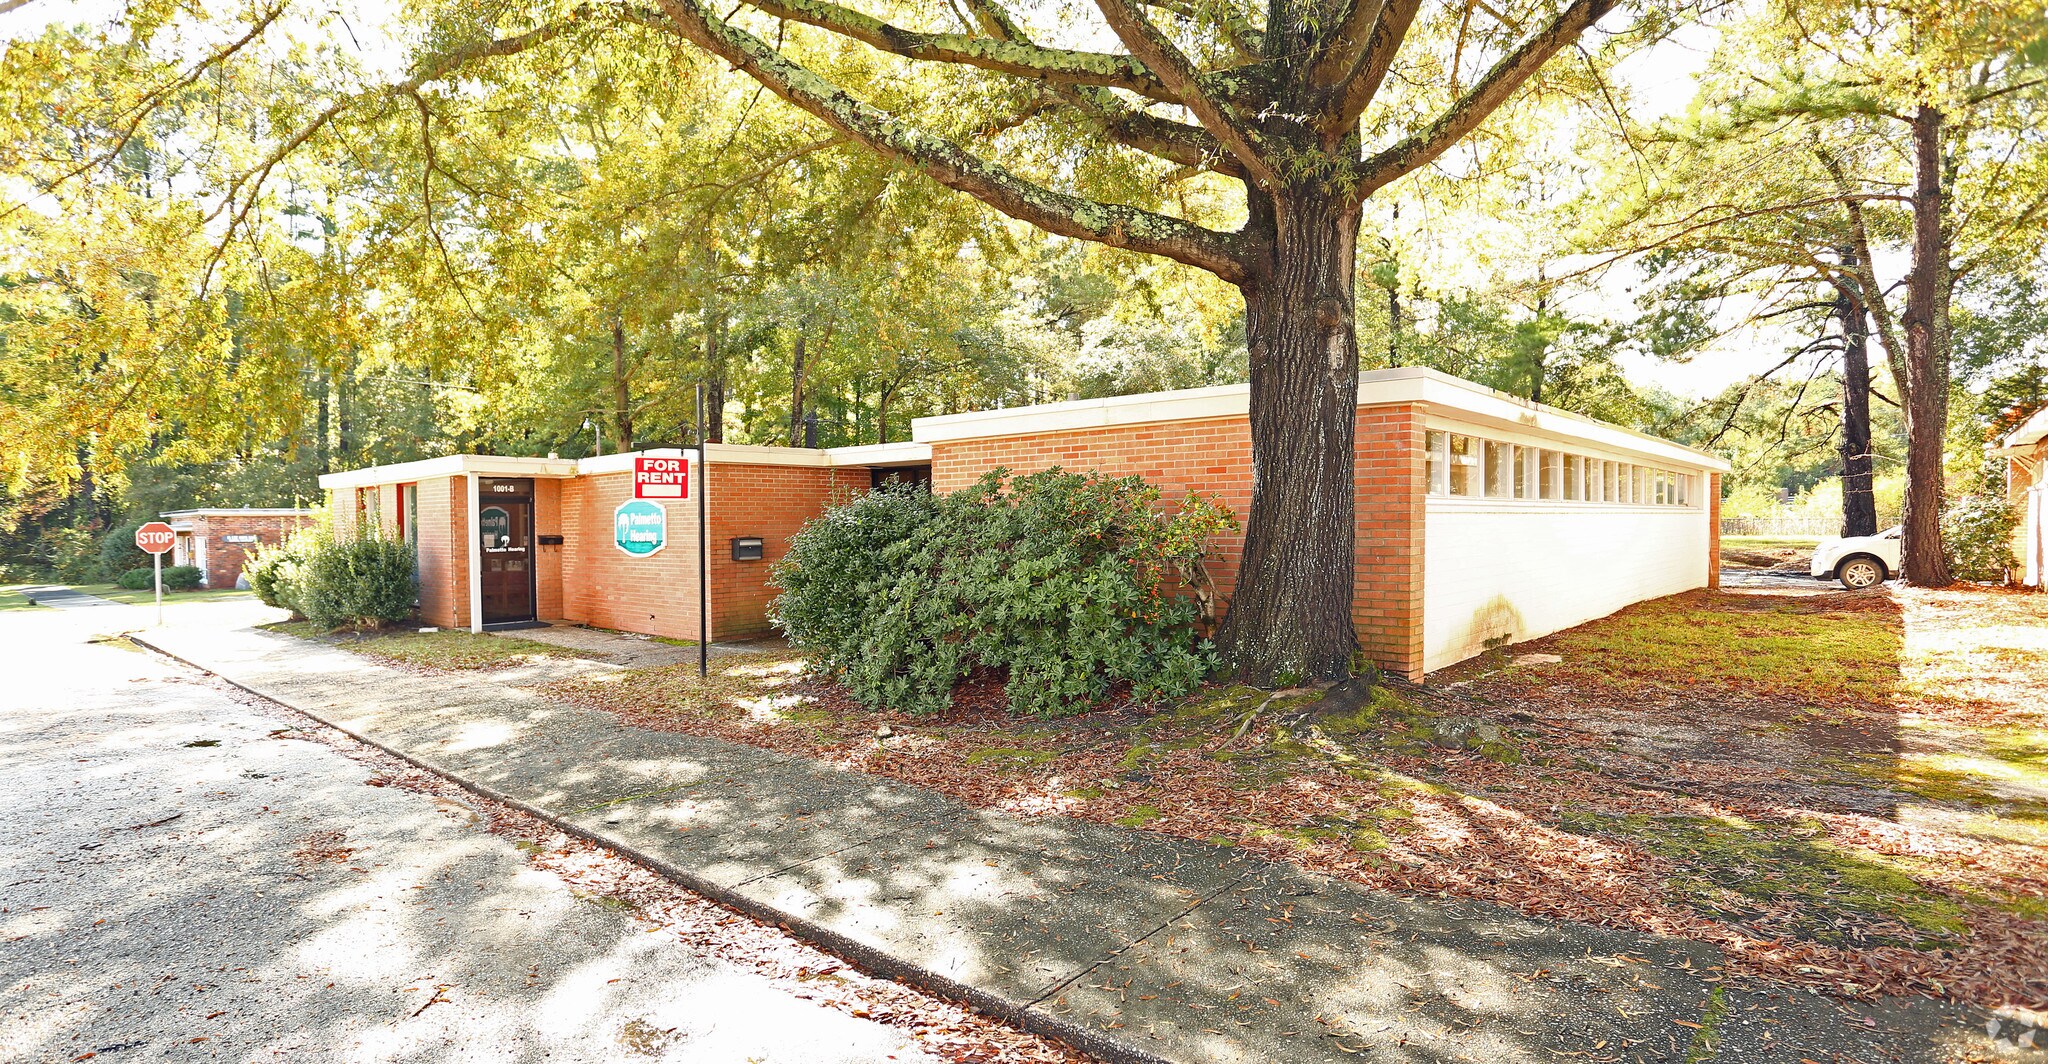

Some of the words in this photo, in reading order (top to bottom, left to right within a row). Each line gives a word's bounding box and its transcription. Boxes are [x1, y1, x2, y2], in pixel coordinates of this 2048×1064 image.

[643, 460, 680, 471] FOR
[637, 472, 686, 483] RENT
[493, 485, 515, 493] 1001-B
[630, 512, 662, 525] Palmetto
[139, 531, 174, 545] STOP
[630, 530, 657, 545] Hearing
